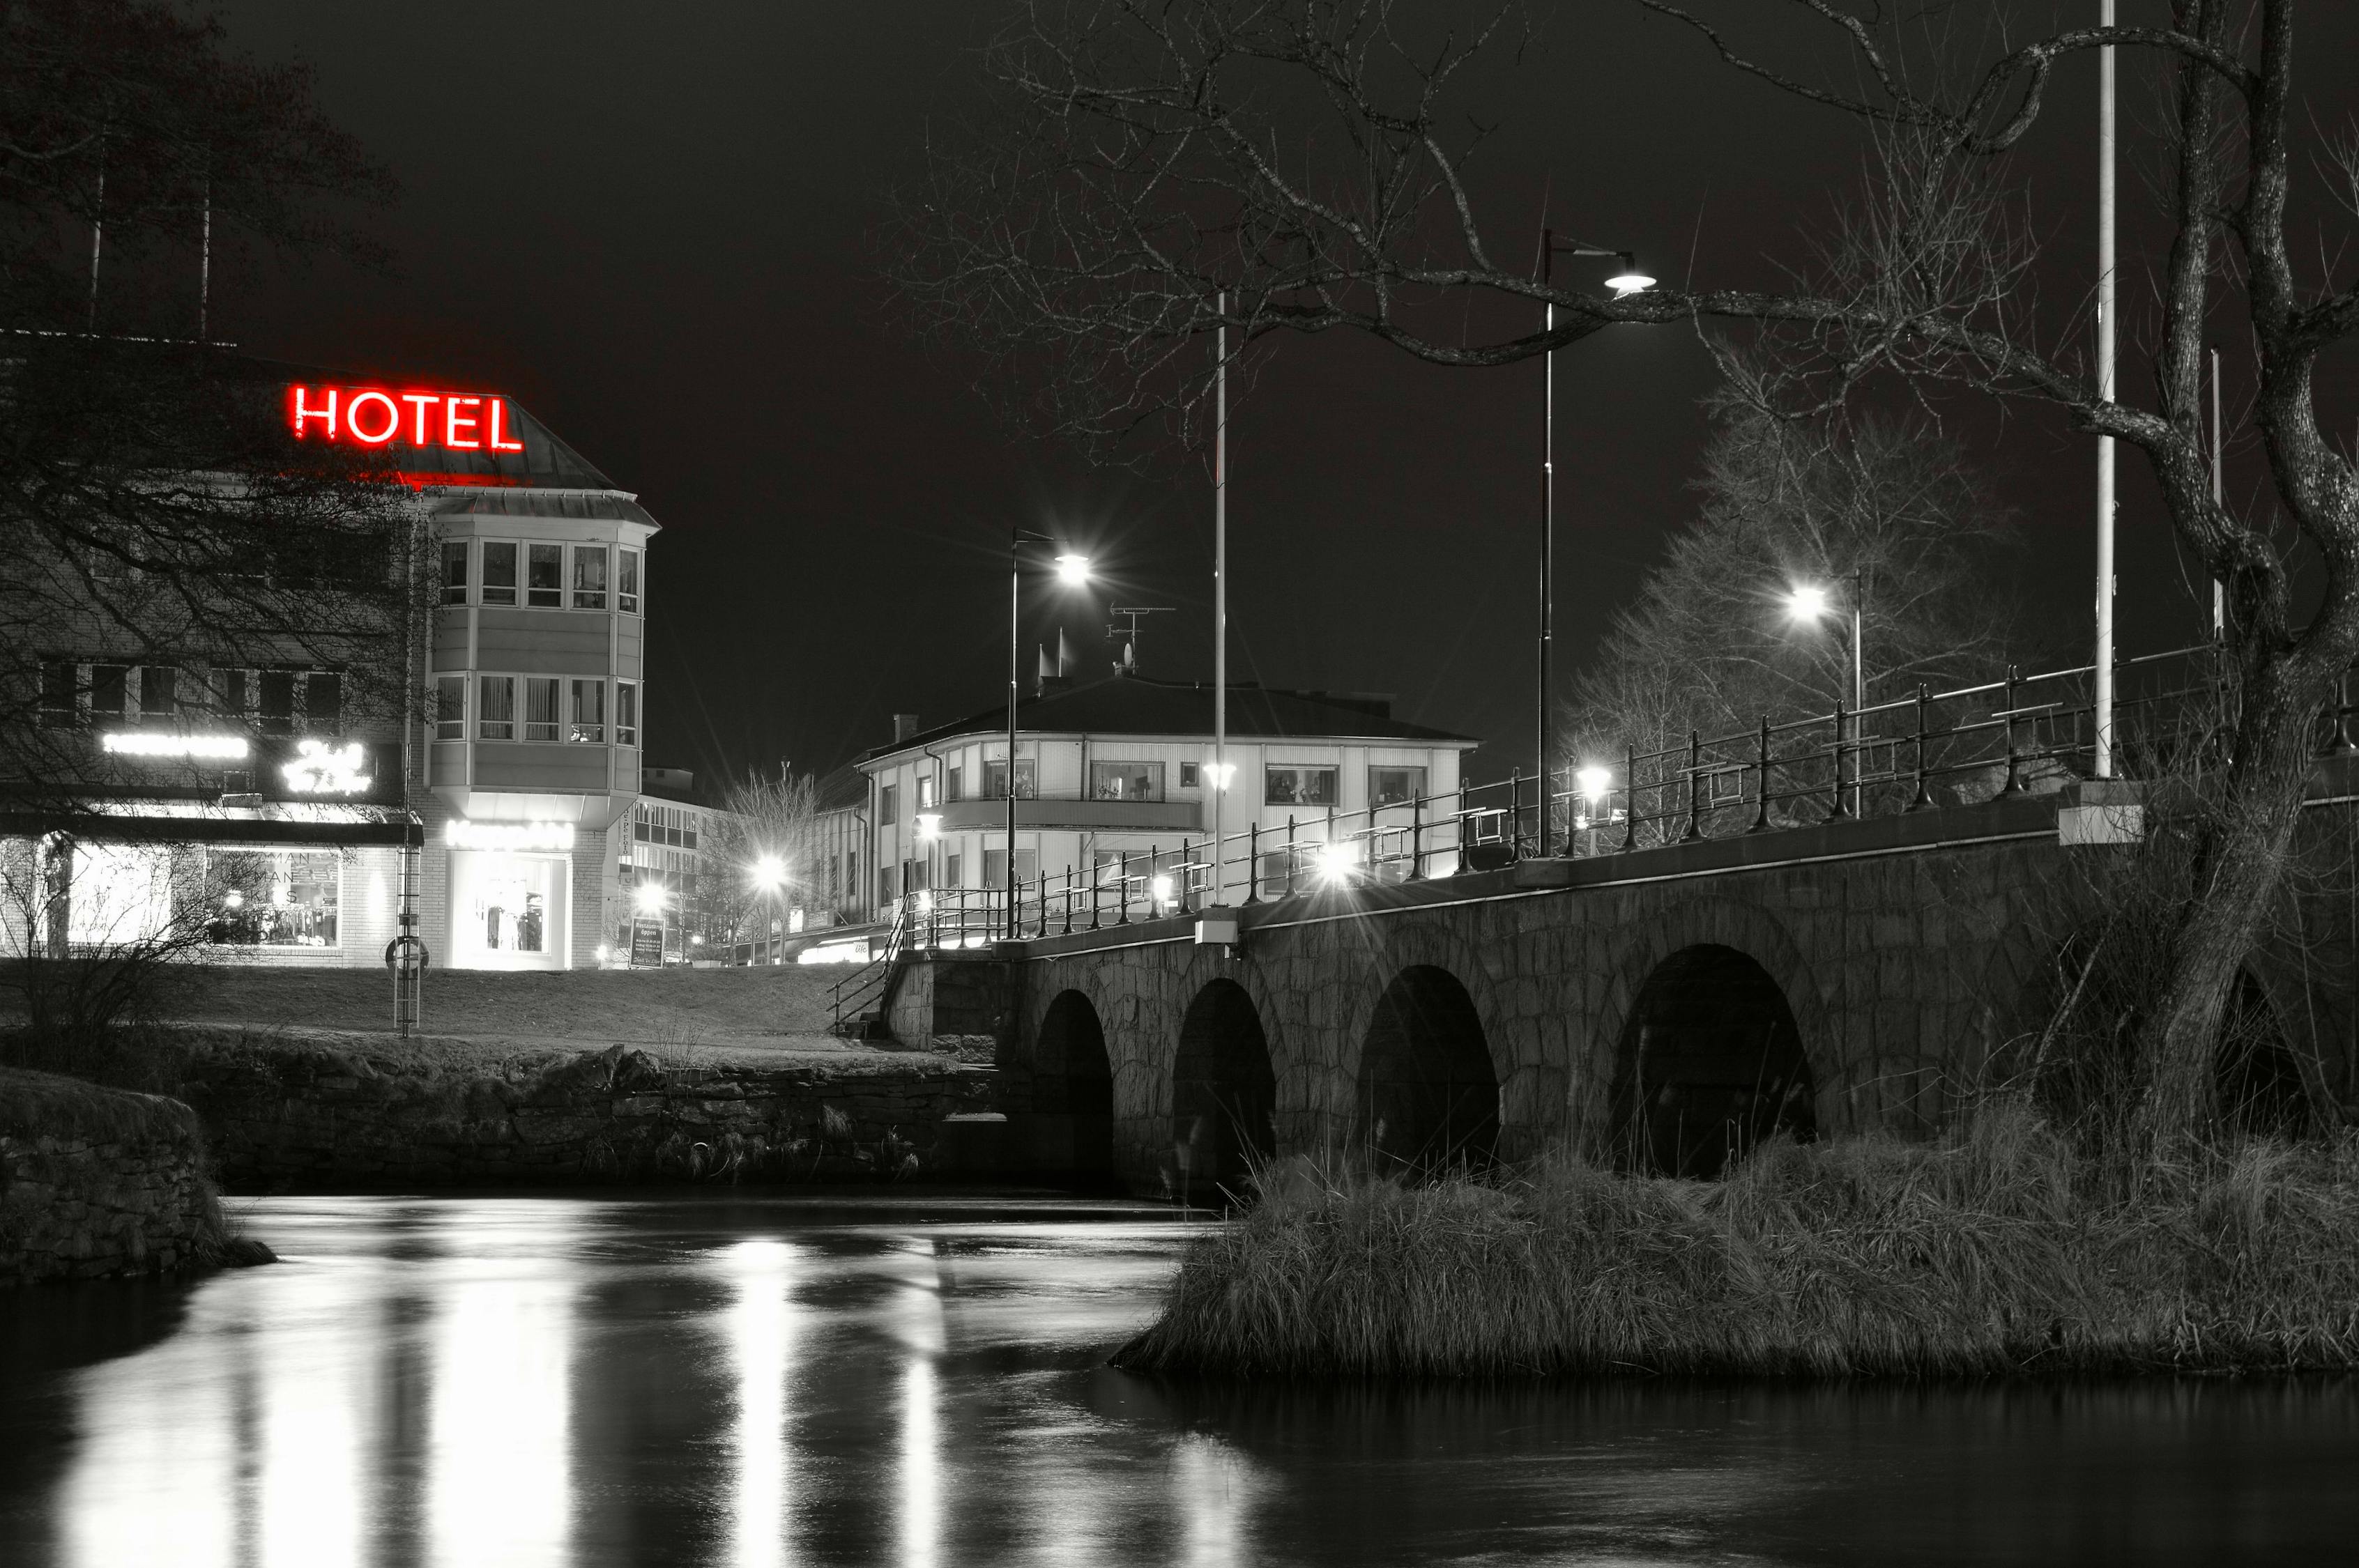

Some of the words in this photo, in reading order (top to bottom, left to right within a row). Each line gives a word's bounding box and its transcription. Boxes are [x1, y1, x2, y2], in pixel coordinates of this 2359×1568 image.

[294, 387, 523, 452] HOTEL
[254, 871, 294, 883] MAN
[251, 890, 297, 903] KIS
